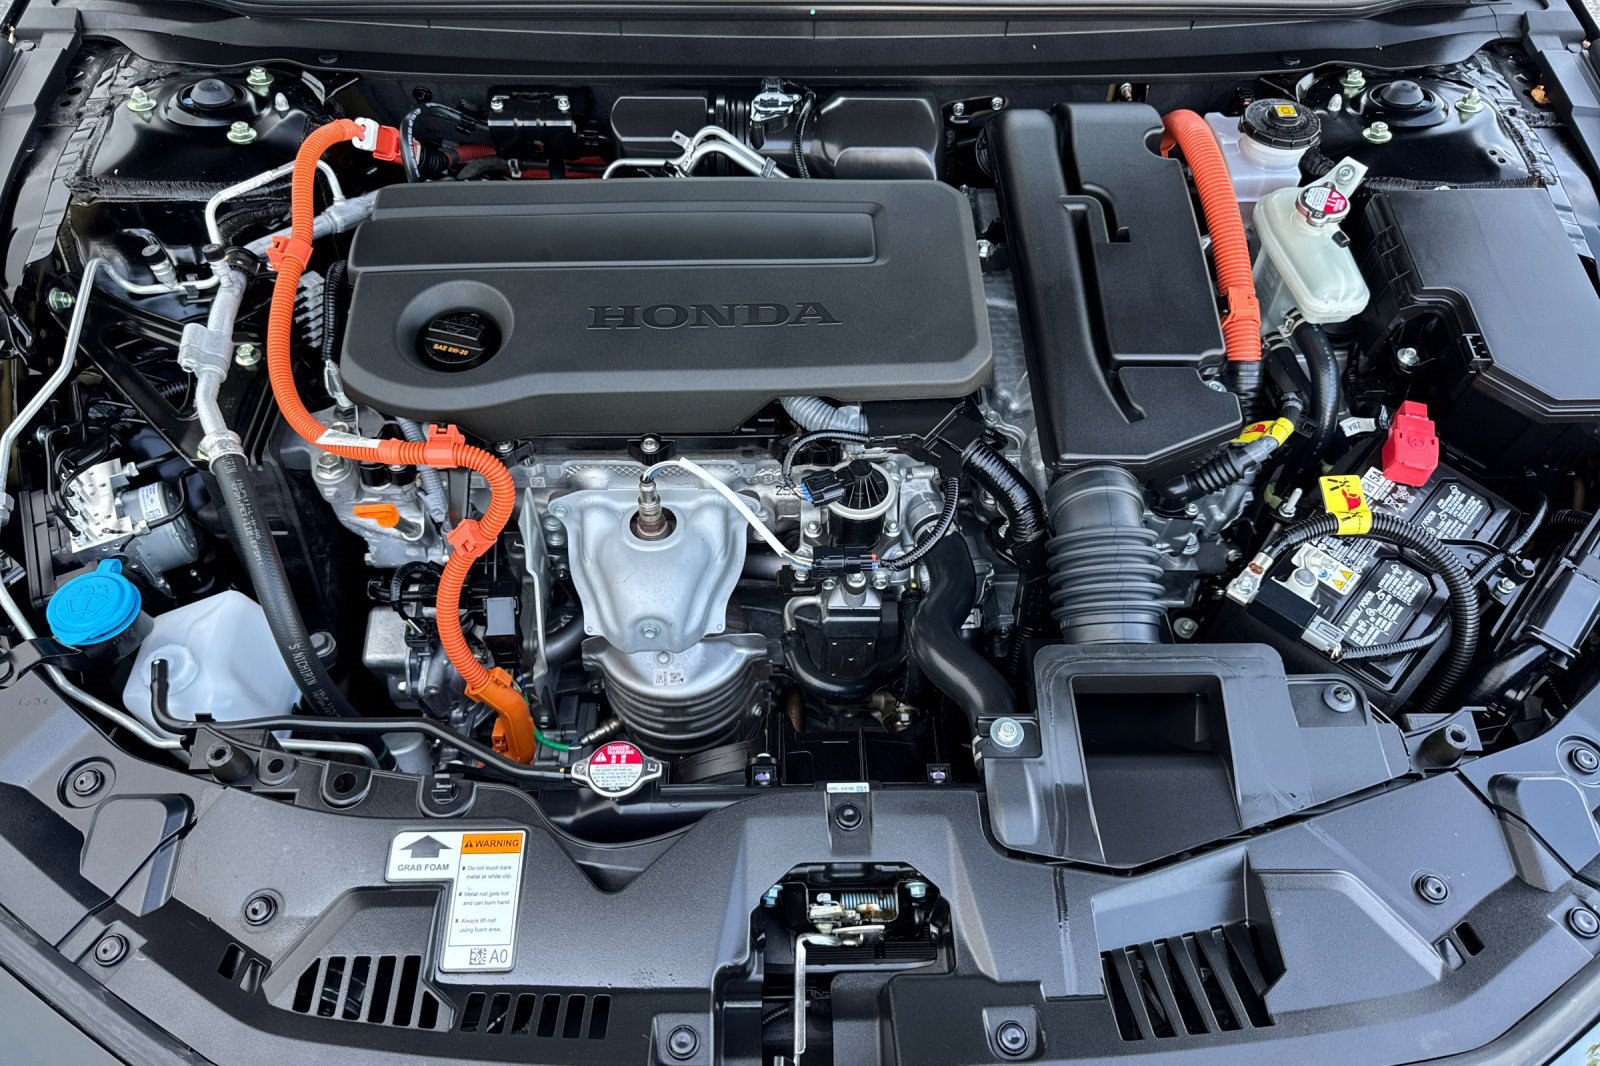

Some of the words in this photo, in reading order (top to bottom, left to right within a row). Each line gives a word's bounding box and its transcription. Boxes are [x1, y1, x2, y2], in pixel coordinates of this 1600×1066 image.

[586, 302, 843, 330] HONDA
[433, 343, 448, 352] SAE
[447, 346, 469, 356] 0W-20
[475, 839, 520, 848] WARNING
[424, 863, 450, 871] FOAM
[488, 948, 508, 964] A0
